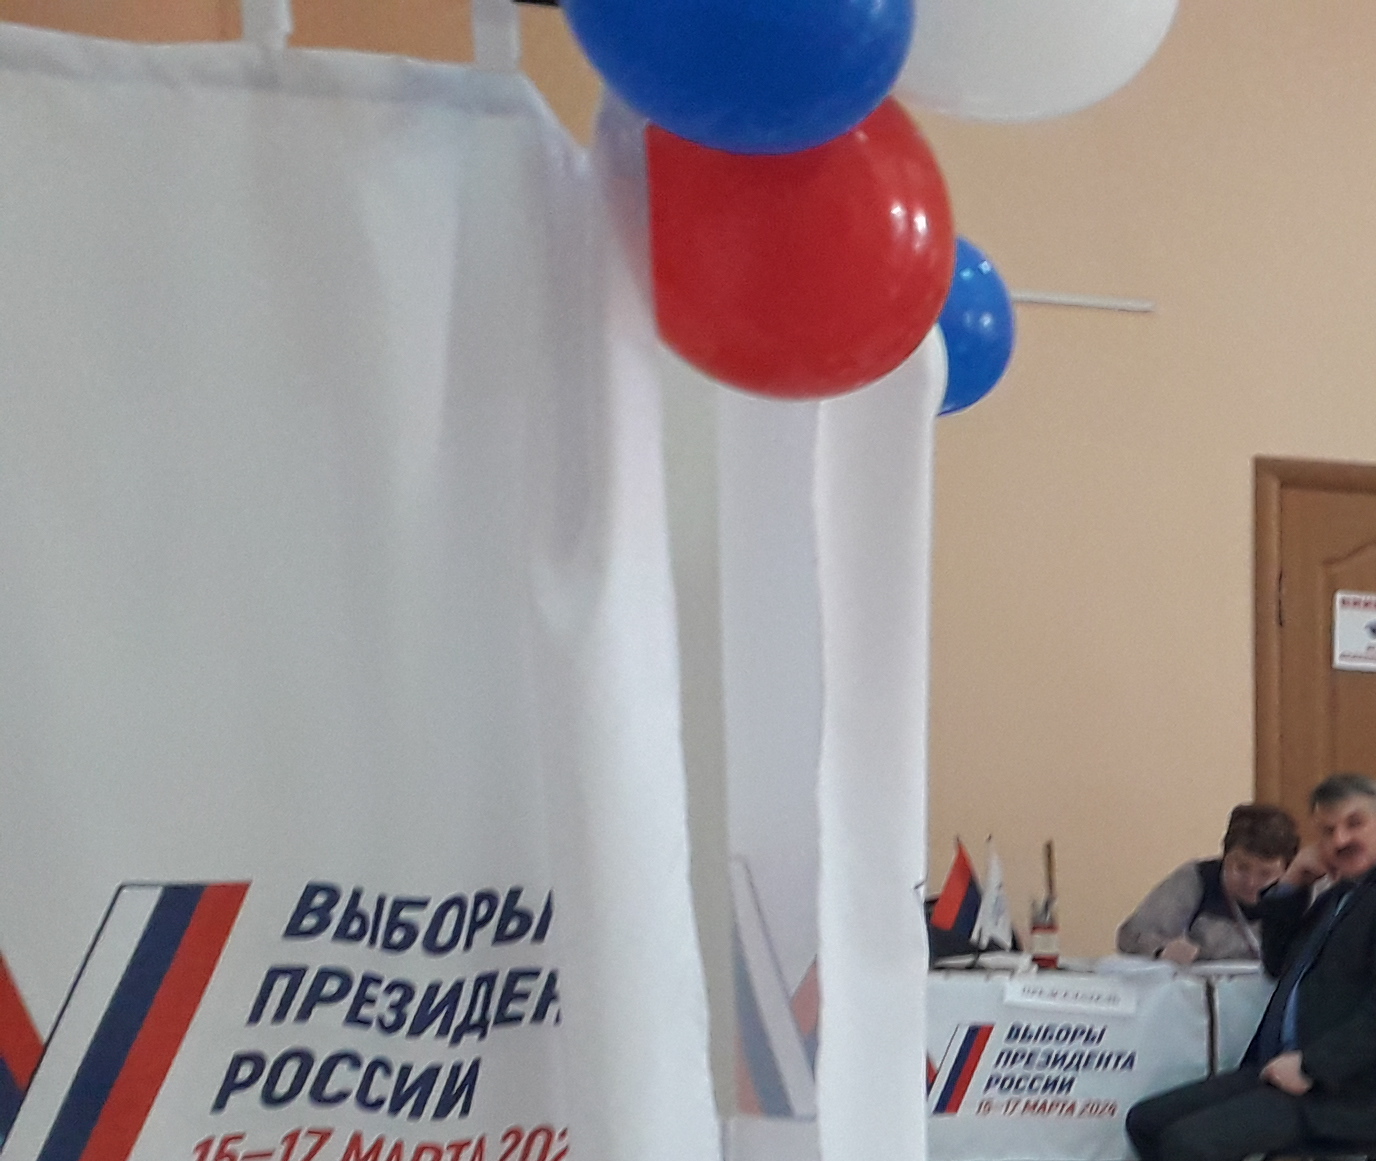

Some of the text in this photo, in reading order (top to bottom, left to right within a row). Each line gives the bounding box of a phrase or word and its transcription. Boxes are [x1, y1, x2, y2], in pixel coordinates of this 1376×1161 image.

[282, 880, 555, 957] ВЫБОРЫ
[1004, 1023, 1108, 1044] ВЫБОРЫ
[993, 1050, 1137, 1072] ПРЕЗИДЕНТА
[211, 1045, 482, 1121] РОССИИ
[983, 1073, 1077, 1095] РОССИИ
[1020, 1099, 1077, 1115] МАРТА
